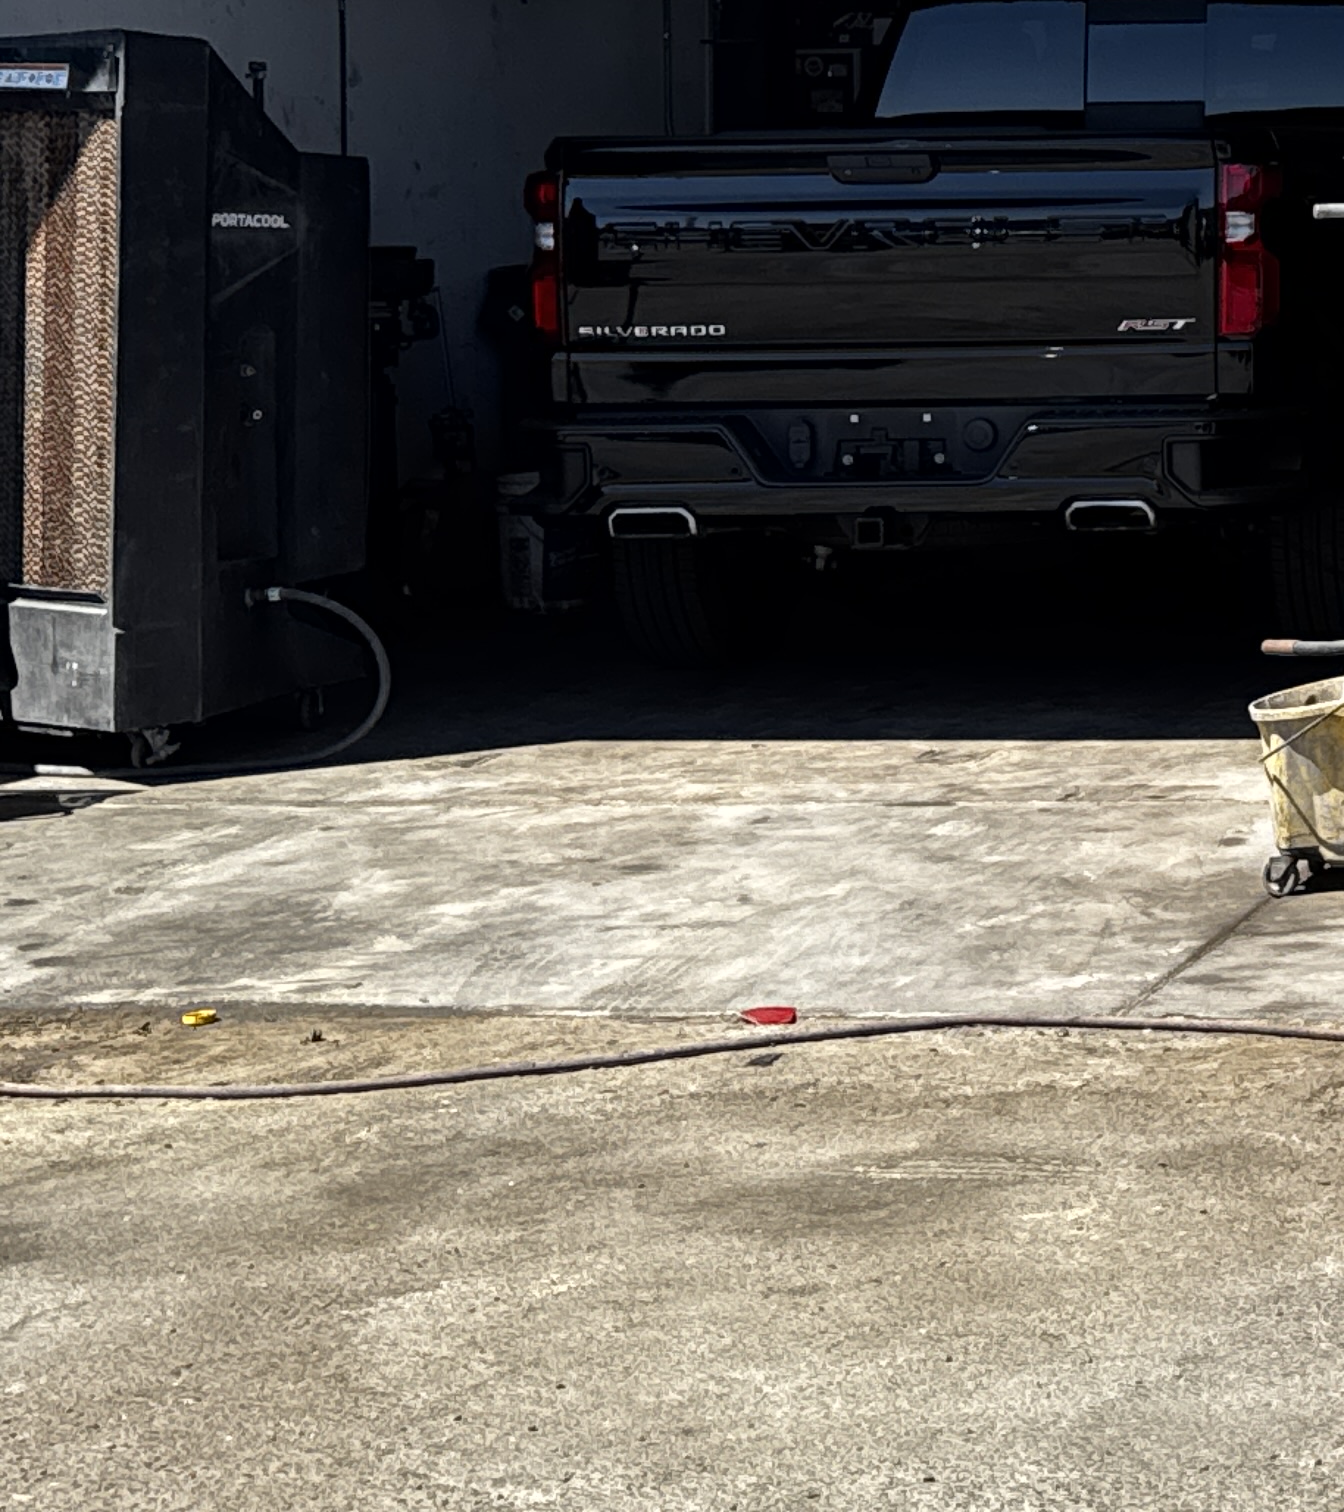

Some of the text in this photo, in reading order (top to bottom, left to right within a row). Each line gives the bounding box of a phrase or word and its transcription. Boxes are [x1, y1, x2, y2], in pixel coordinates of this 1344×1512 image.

[210, 212, 291, 229] PORTACOOL
[577, 323, 727, 338] SILVERADO
[1116, 316, 1197, 332] RST
